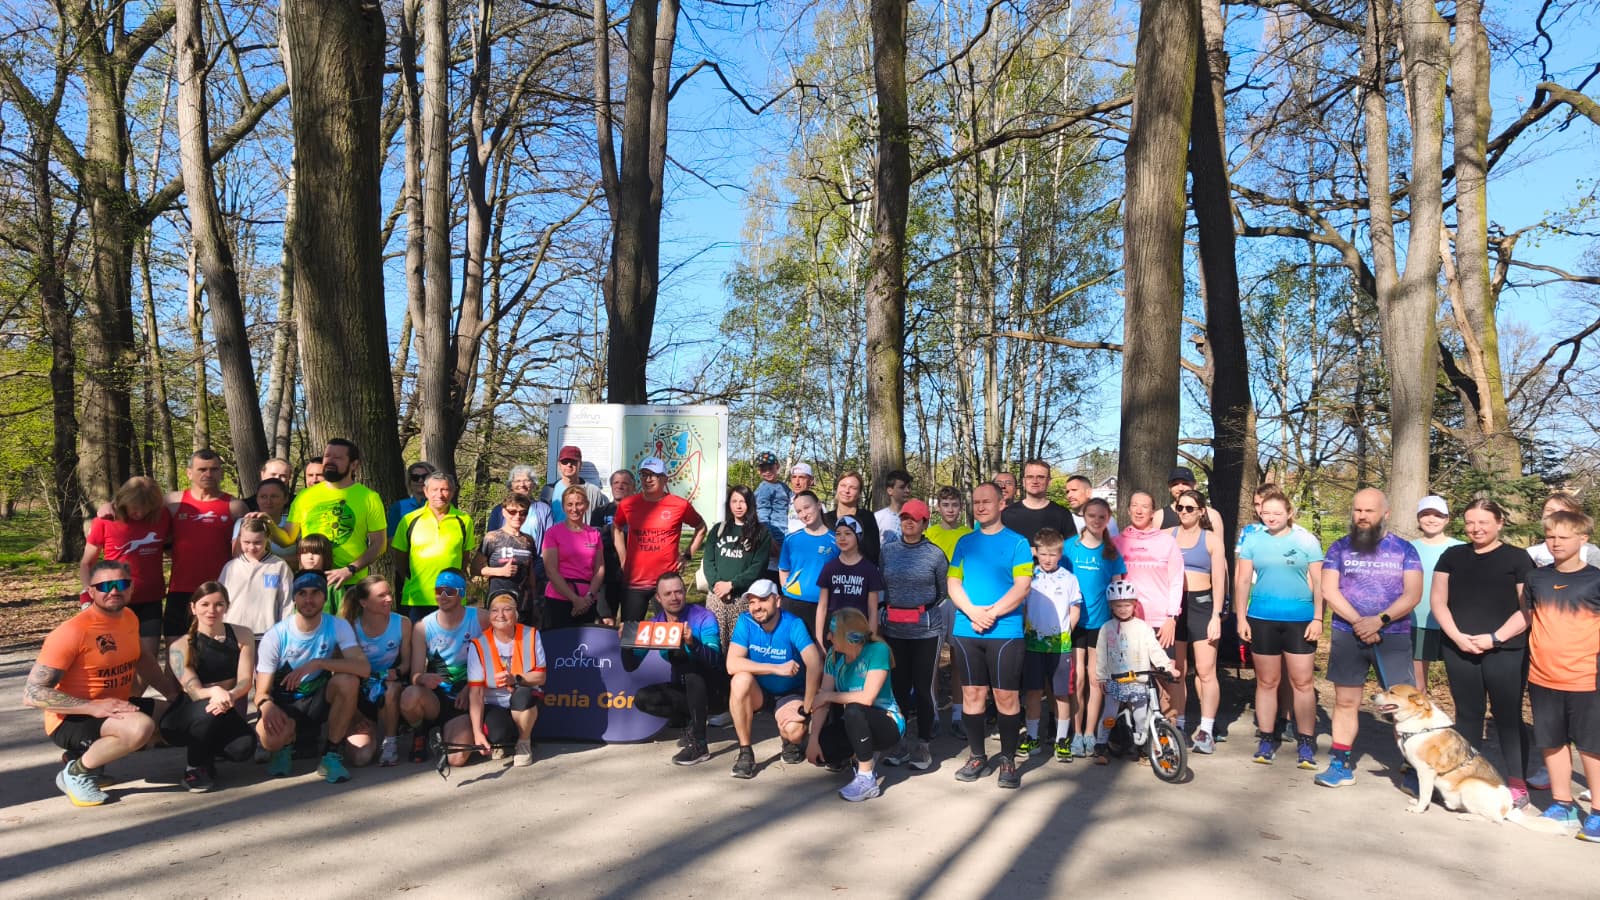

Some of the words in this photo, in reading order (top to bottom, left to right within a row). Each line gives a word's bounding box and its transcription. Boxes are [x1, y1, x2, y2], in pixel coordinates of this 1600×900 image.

[640, 544, 661, 552] TEAM
[720, 547, 744, 559] PARIS
[832, 574, 865, 586] CHOJNIK
[843, 584, 863, 596] TEAM
[637, 624, 680, 645] 499
[555, 646, 612, 669] parkrun
[544, 690, 590, 708] enia
[597, 691, 635, 709] Gór
